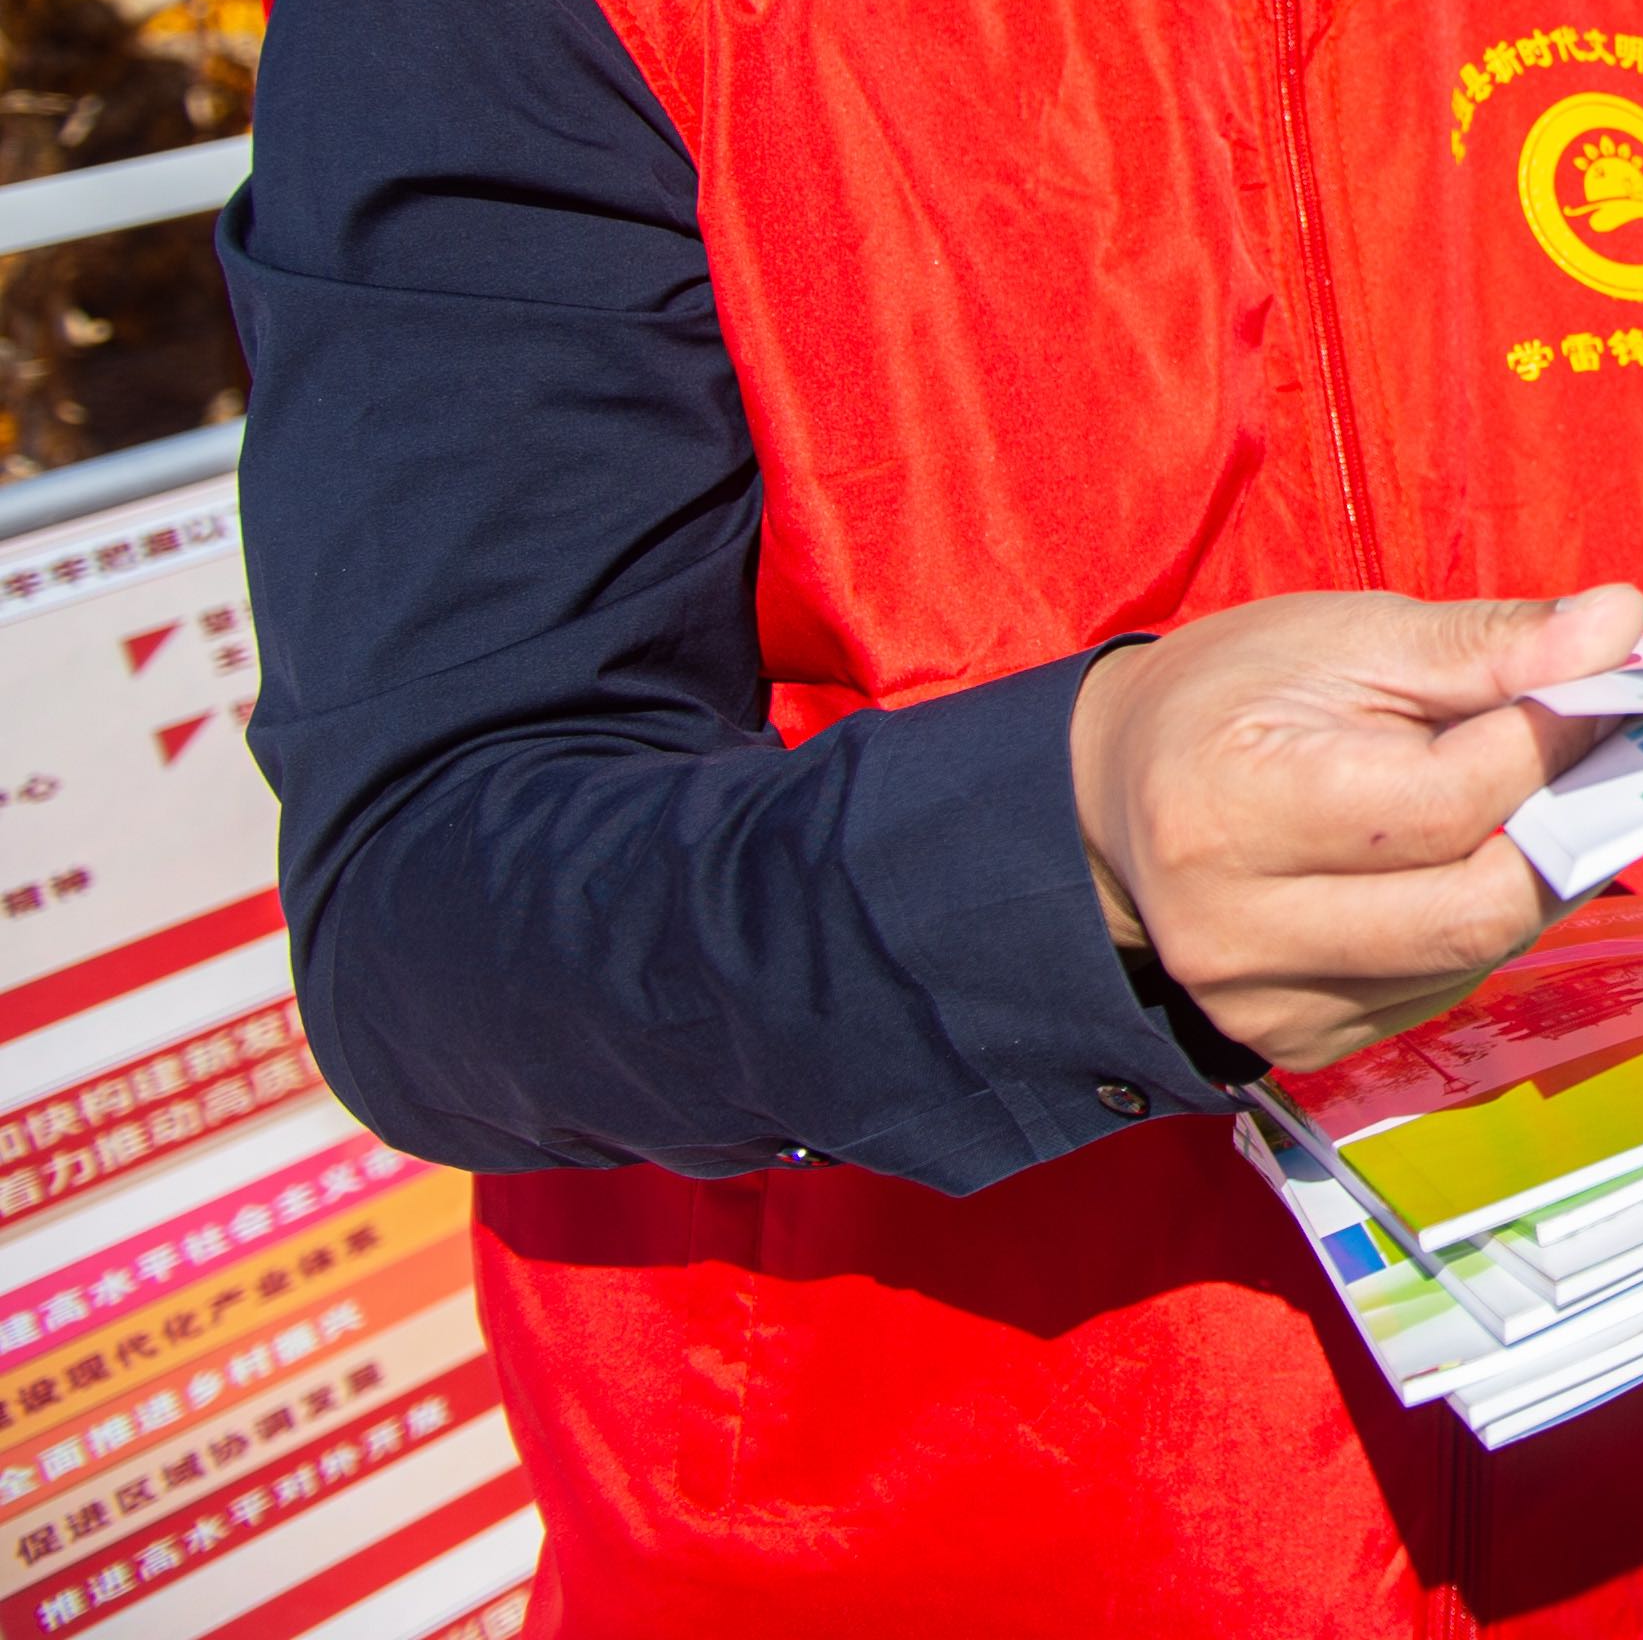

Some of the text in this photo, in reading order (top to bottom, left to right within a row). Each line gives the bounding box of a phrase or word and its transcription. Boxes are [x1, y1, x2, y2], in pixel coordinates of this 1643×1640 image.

[0, 1003, 303, 1161] 快构建新发
[0, 1045, 320, 1218] 着力推动高质
[0, 1298, 364, 1506] 全面推进乡村振兴
[17, 1359, 384, 1568] 促进区域协调发展
[35, 1393, 454, 1633] 推进高水平对外开放
